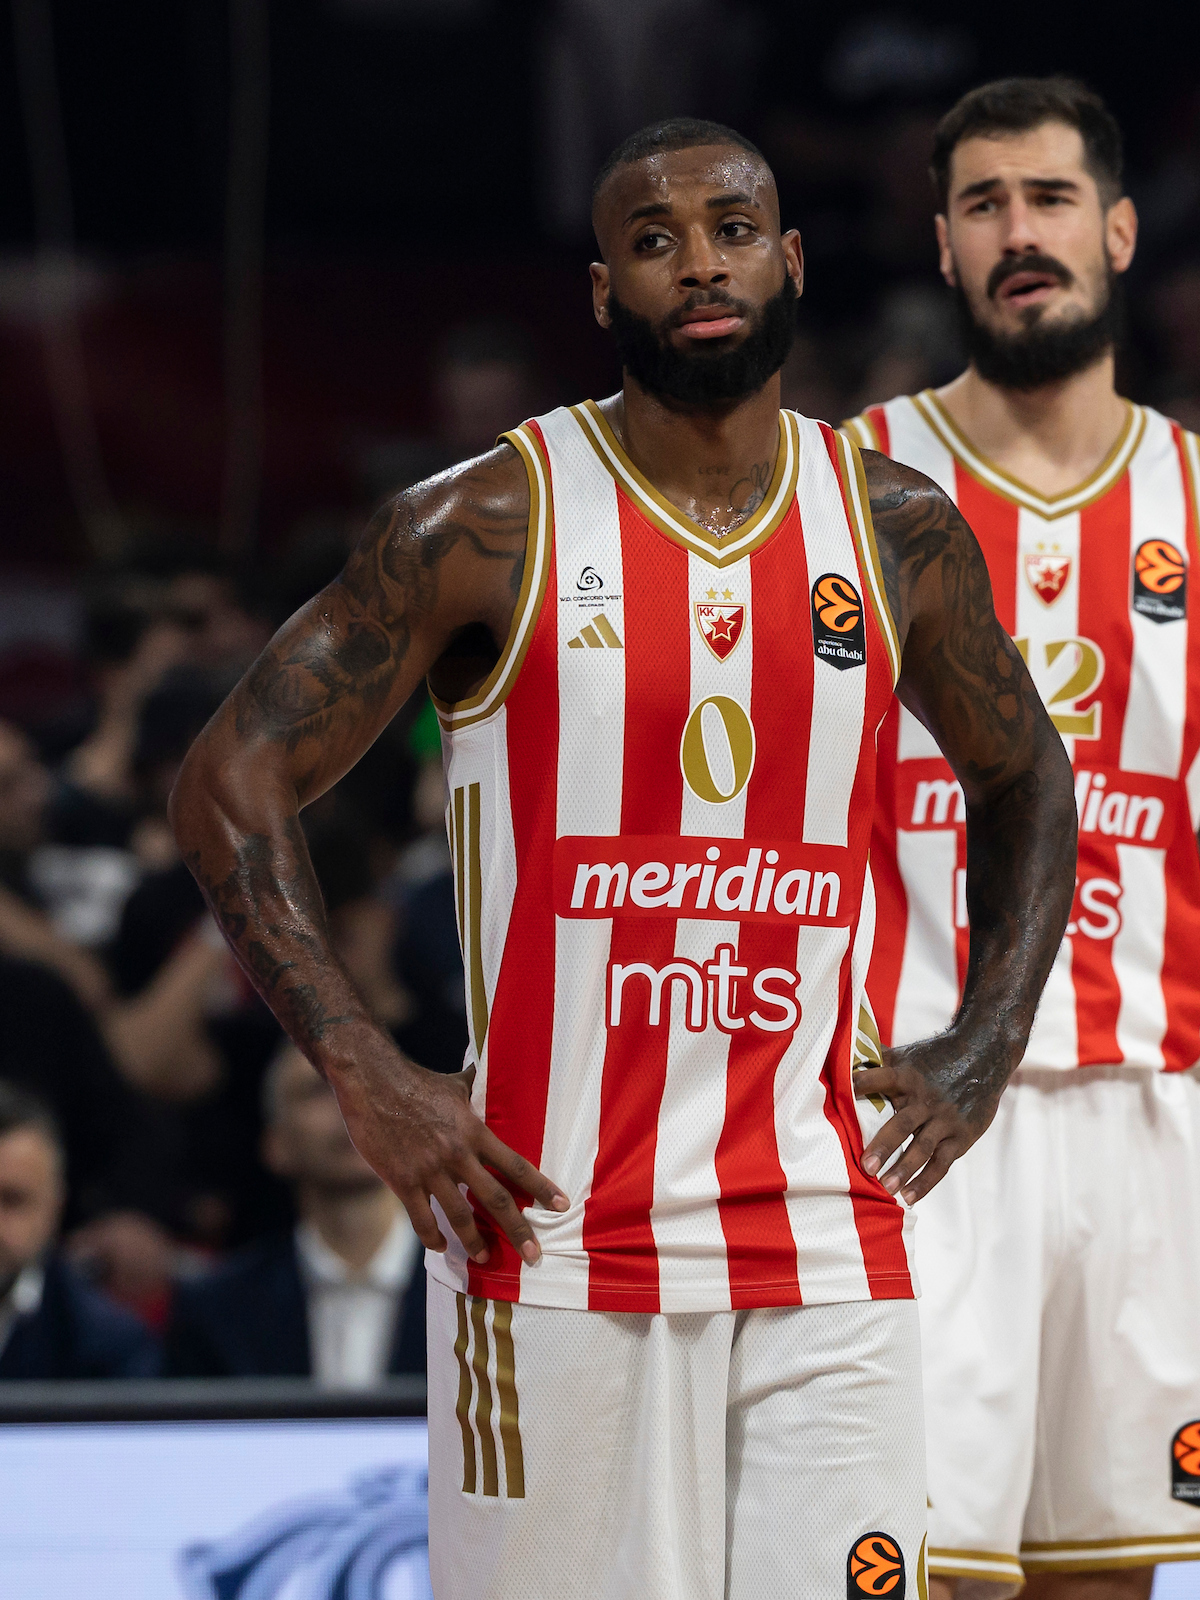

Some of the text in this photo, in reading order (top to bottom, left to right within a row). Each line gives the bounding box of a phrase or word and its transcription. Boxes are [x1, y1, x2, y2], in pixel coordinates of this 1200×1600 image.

[817, 644, 863, 661] abu dhabi
[679, 692, 756, 806] 0
[570, 846, 841, 918] meridian
[609, 948, 799, 1032] mts
